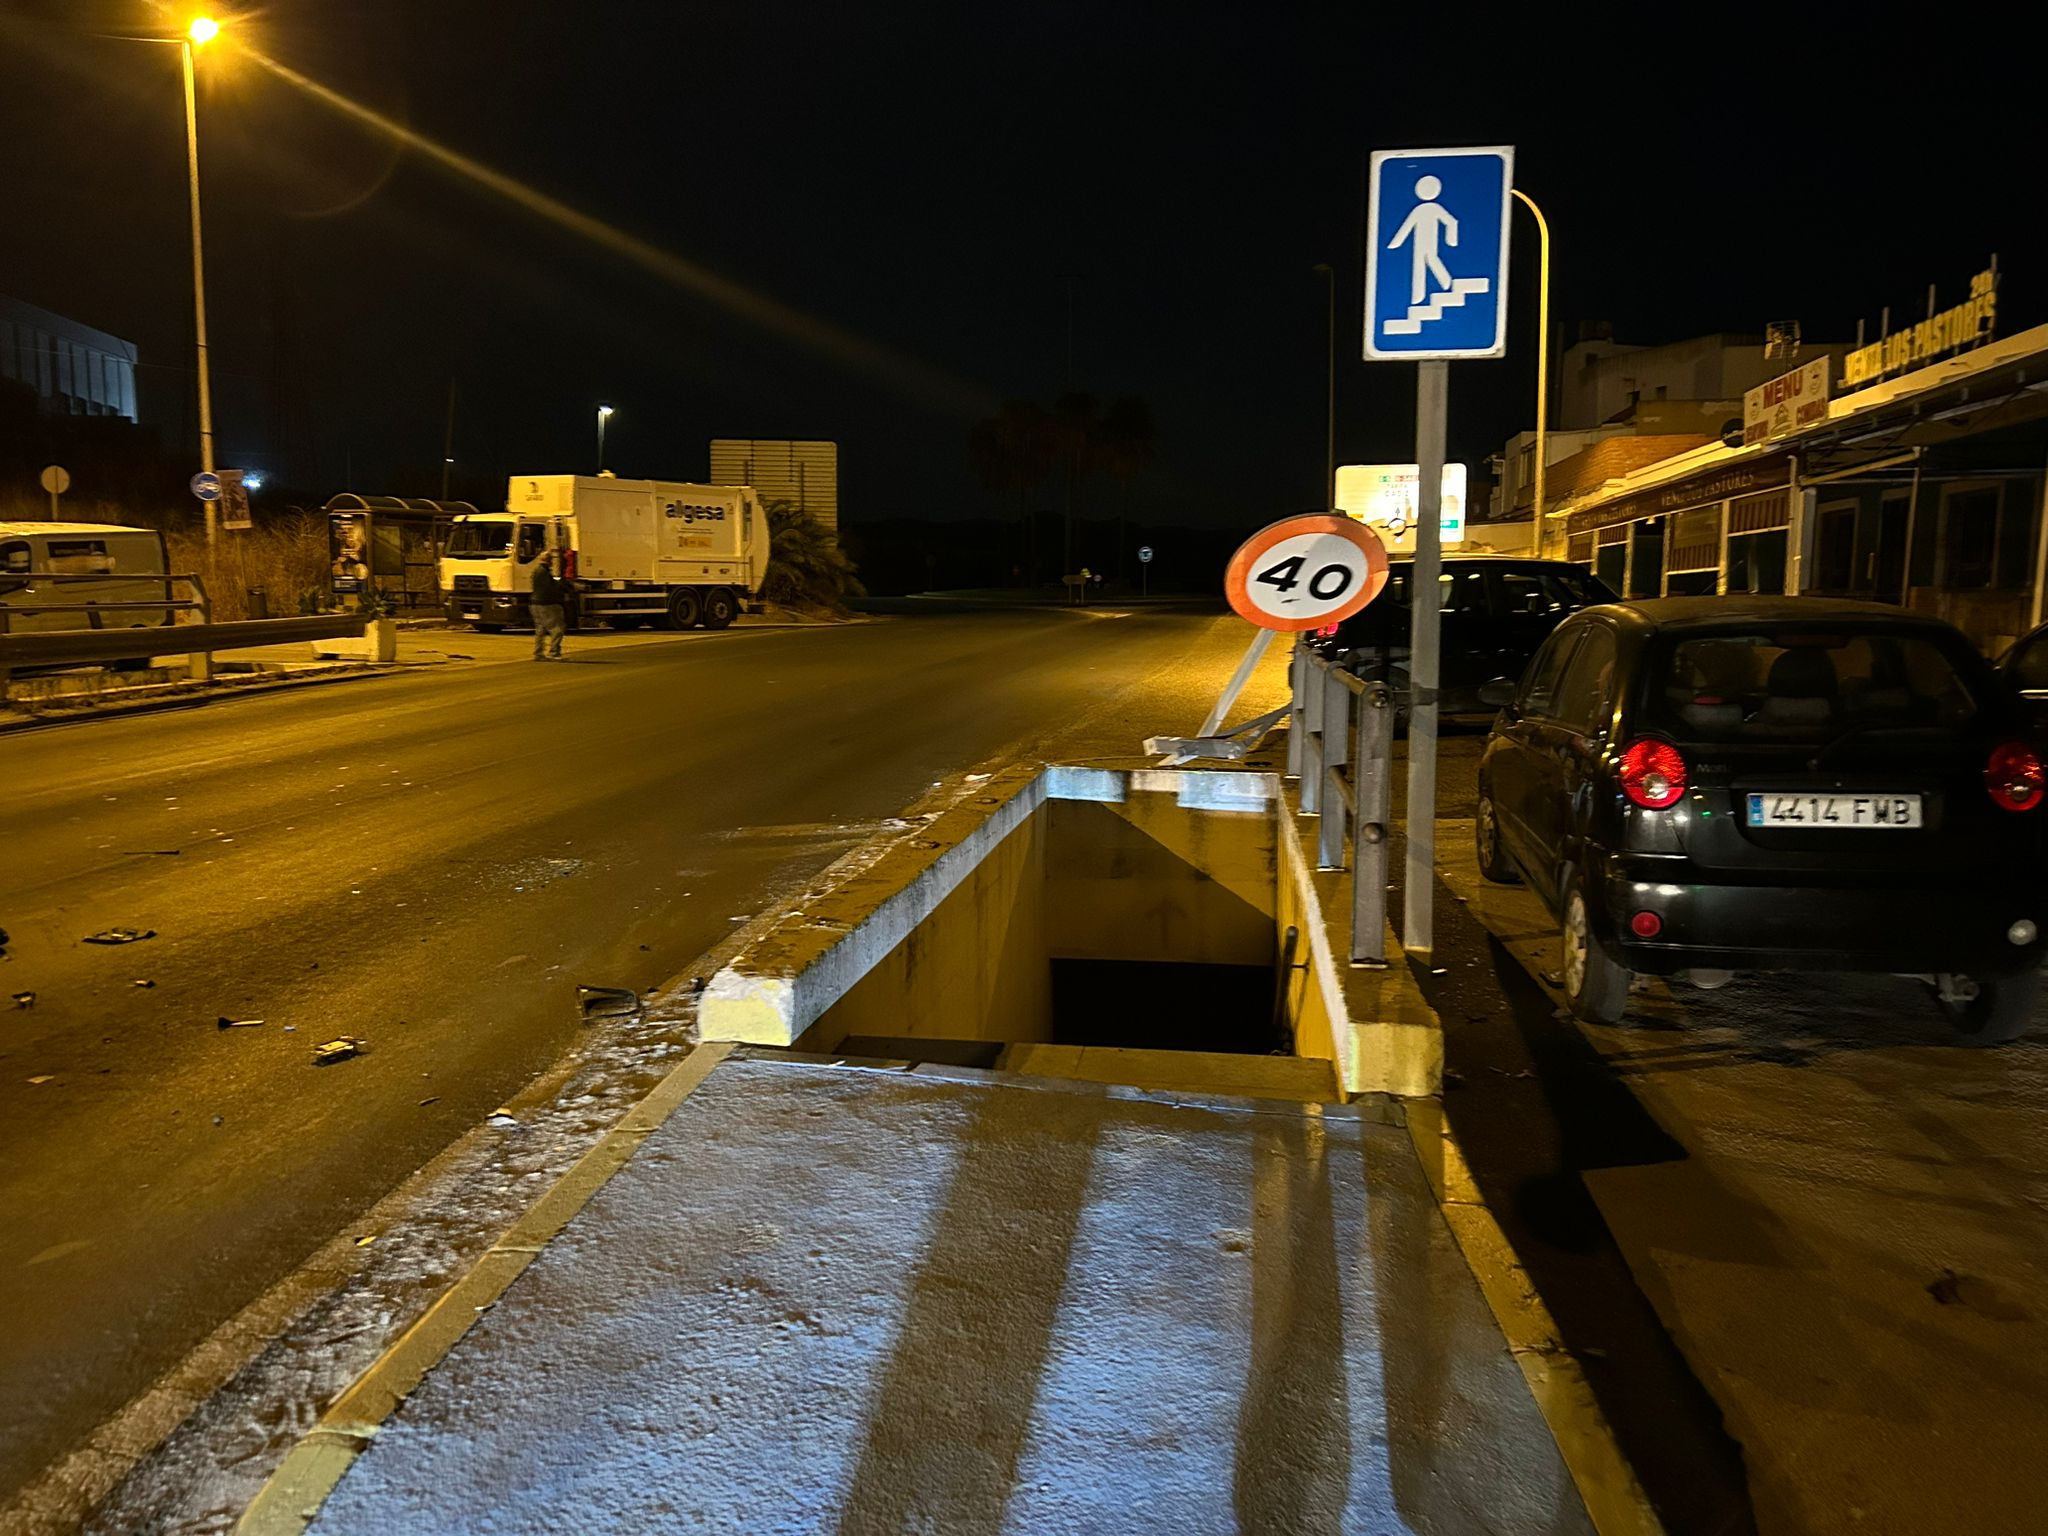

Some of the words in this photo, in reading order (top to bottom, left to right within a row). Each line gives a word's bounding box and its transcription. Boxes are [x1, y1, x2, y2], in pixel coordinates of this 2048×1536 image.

[1914, 291, 1997, 359] PASTORES
[665, 500, 725, 524] algesa
[1256, 556, 1352, 601] 40
[1770, 797, 1840, 823] 4414
[1852, 799, 1911, 825] FWB
